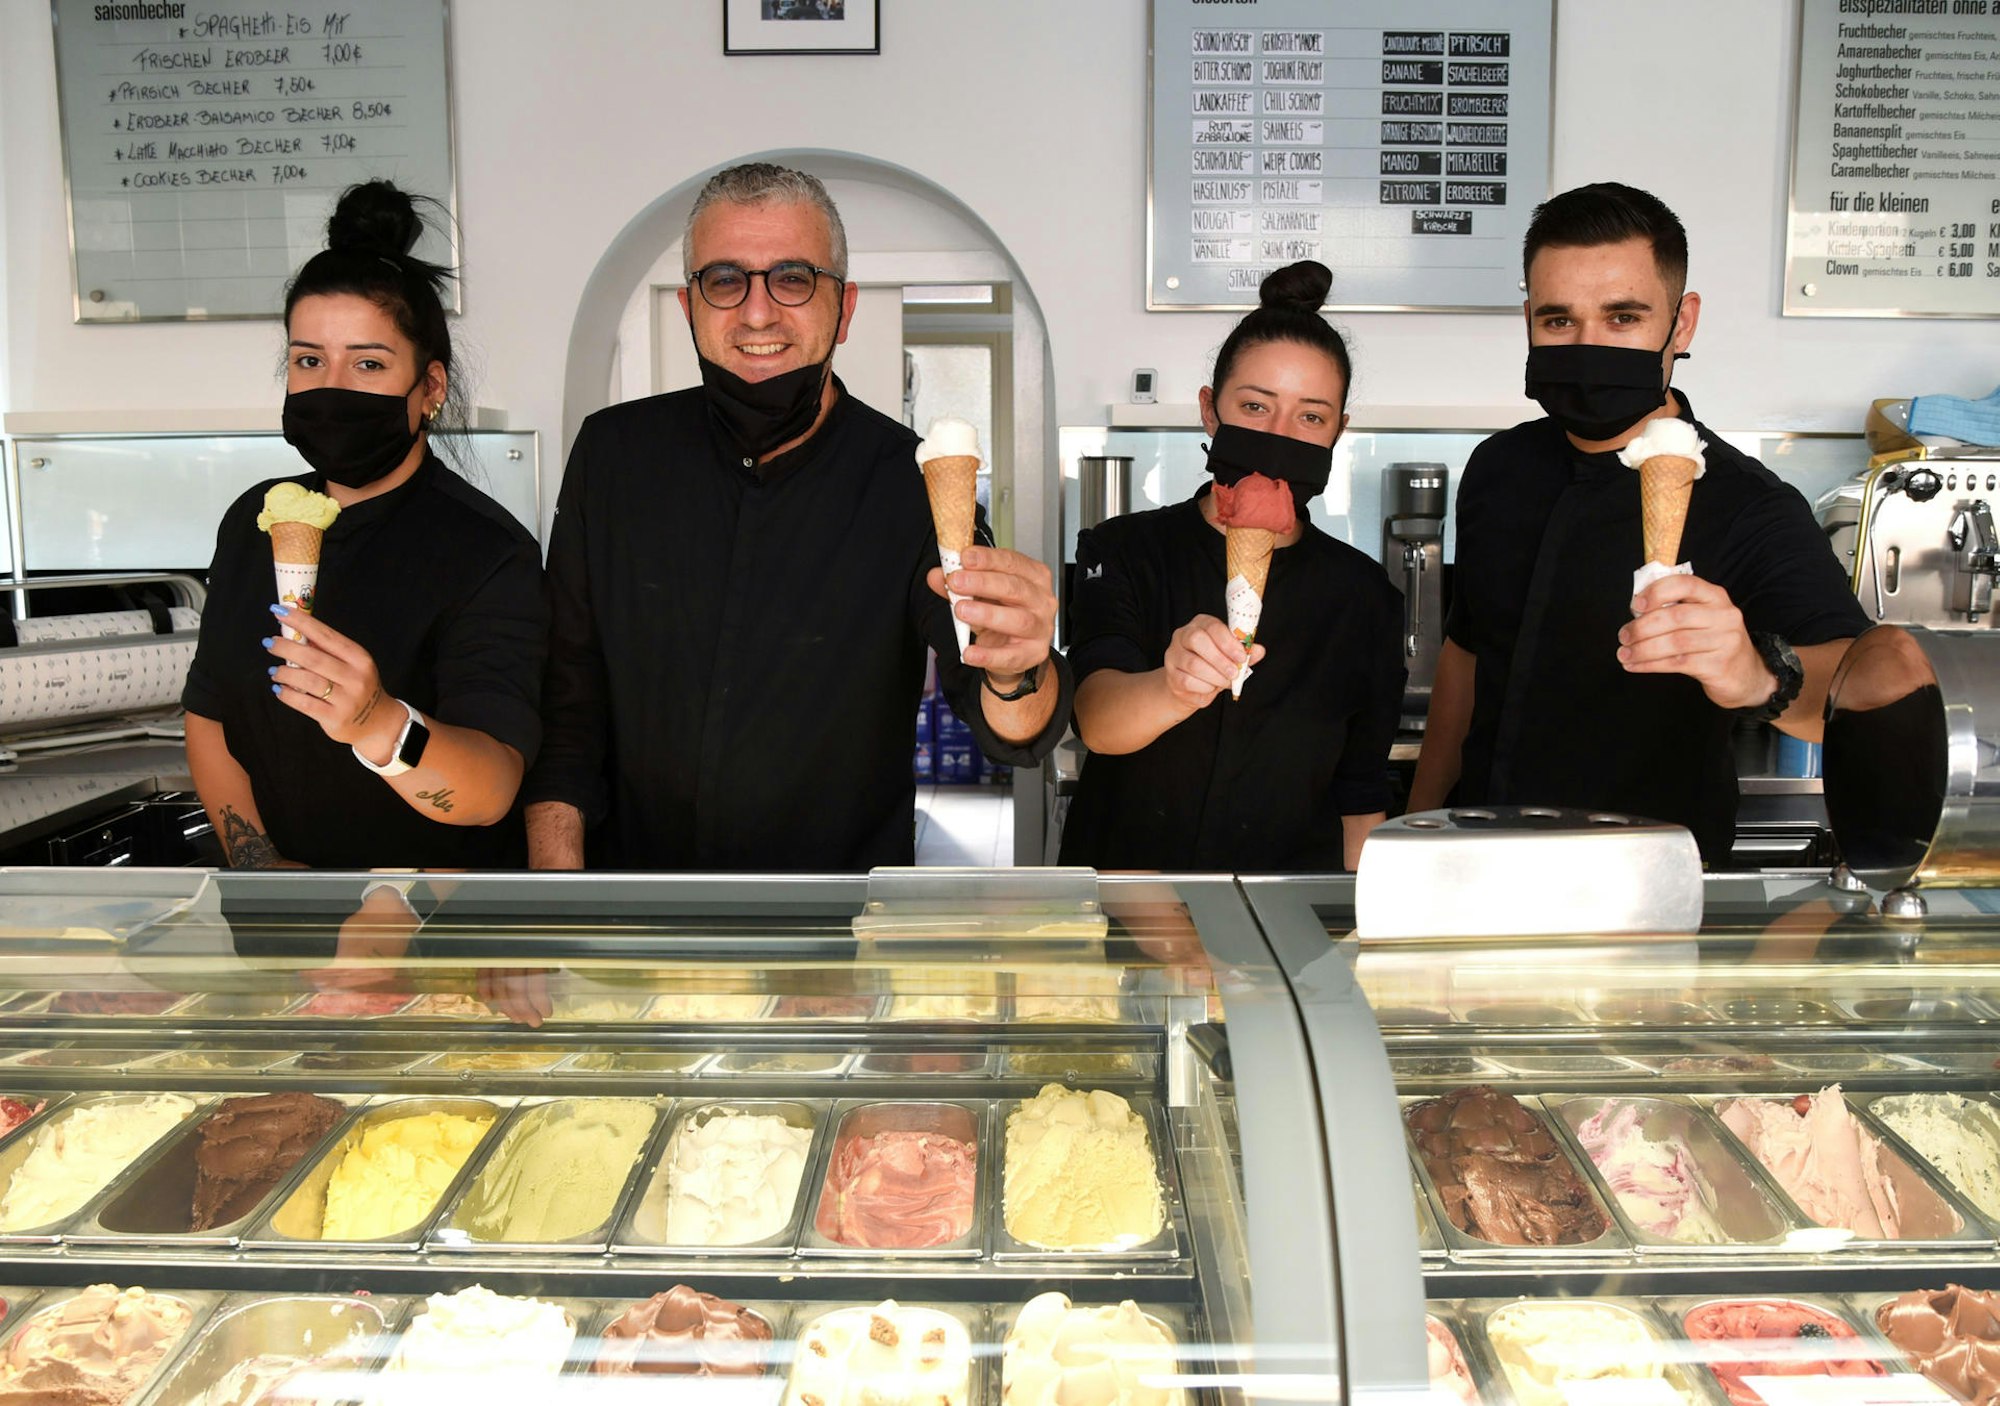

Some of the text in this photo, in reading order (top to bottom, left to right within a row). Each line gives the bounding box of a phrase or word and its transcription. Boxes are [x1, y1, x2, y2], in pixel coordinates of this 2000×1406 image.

[95, 0, 186, 21] saisonbecher
[1838, 23, 1908, 39] Fruchtbecher
[1908, 32, 1955, 41] gemischtes
[132, 48, 212, 71] FRISCHEN
[225, 47, 290, 68] ERDBEER
[1837, 43, 1923, 60] Amarenabecher
[1925, 52, 1972, 61] gemischtes
[1383, 63, 1424, 80] BANANE
[1448, 66, 1507, 82] STACHELBEERE
[1836, 63, 1912, 81] Joghurtbecher
[118, 81, 180, 101] PFIRSICH
[187, 80, 250, 96] BECHER
[1835, 83, 1910, 99] Schokobecher
[1193, 93, 1250, 112] LANDKAFFEE
[1384, 94, 1440, 112] FRUCHTMIX
[1450, 96, 1508, 114] BROMBEEREN
[282, 107, 343, 123] BECHER
[1834, 103, 1917, 119] Kartoffelbecher
[1919, 111, 1966, 121] gemischtes
[1208, 120, 1233, 132] RUM
[1263, 122, 1304, 141] SAHNEEIS
[1833, 123, 1966, 141] Bananensplit gemischtes Eis
[1195, 132, 1253, 143] ZABAGLIONE
[127, 142, 157, 160] LATTE
[236, 138, 302, 155] BECHER
[1832, 143, 1919, 161] Spaghettibecher
[1193, 151, 1244, 171] SCHOKOLADE
[1289, 152, 1322, 171] COOKIES
[1382, 154, 1420, 171] MANGO
[1447, 153, 1499, 172] MIRABELLE
[134, 171, 191, 188] COOKIES
[195, 169, 256, 184] BECHER
[1831, 162, 1996, 180] Caramelbecher gemischtes Milcheis
[1193, 181, 1246, 200] HASELNUSS
[1263, 181, 1300, 200] PISTAZIE
[1381, 184, 1431, 201] ZITRONE
[1446, 185, 1494, 202] ERDBEERE
[1830, 191, 1930, 213] für die kleinen
[1194, 211, 1237, 230] NOUGAT
[1415, 210, 1466, 220] SCHWARZE
[1909, 228, 1937, 240] Kugeln
[1951, 223, 1976, 239] 3,00
[1193, 243, 1232, 260] VANILLE
[1950, 242, 1975, 258] 5,00
[1826, 260, 1860, 276] Clown
[1862, 268, 1909, 278] gemischtes
[1910, 268, 1923, 277] Eis
[1949, 262, 1973, 278] 6,00
